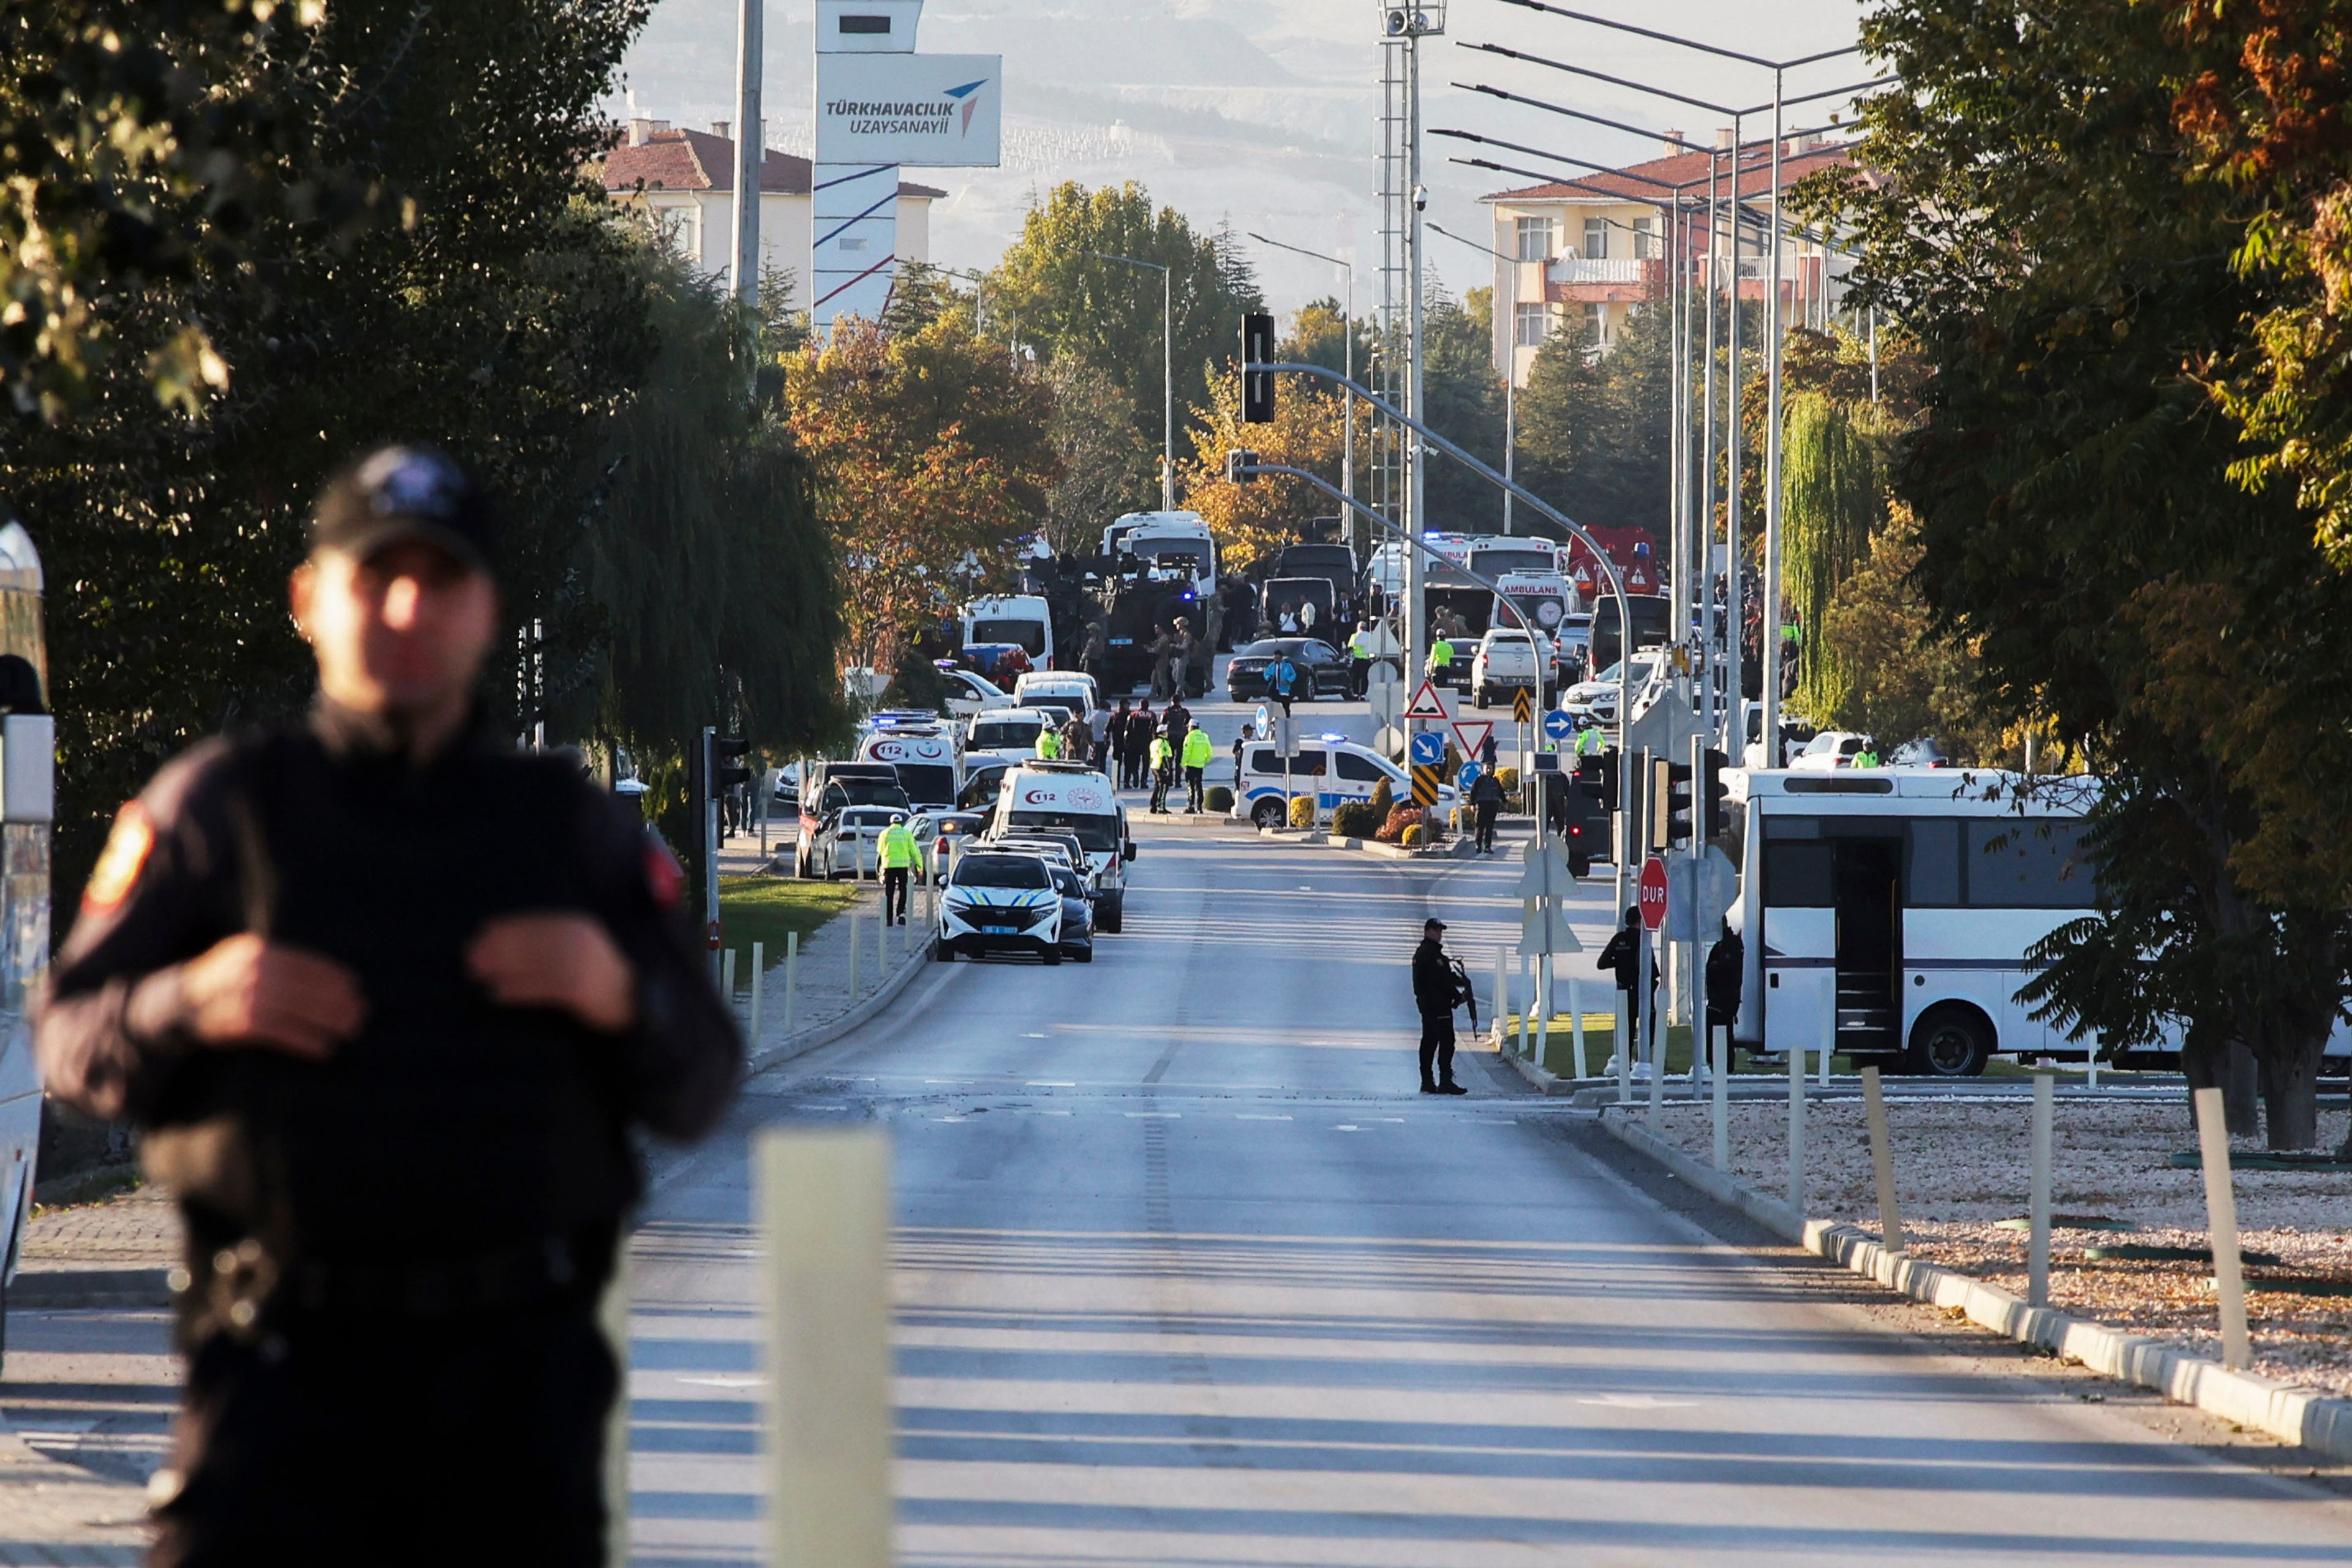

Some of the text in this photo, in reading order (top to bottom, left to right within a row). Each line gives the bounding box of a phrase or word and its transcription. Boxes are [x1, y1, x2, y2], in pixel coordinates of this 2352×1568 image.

[827, 99, 954, 116] TÜRKHAVACILIK
[850, 118, 949, 134] UZAYSANAYİİ
[1504, 586, 1558, 594] AMBULANS
[880, 745, 902, 755] 112
[1643, 885, 1664, 903] DUR
